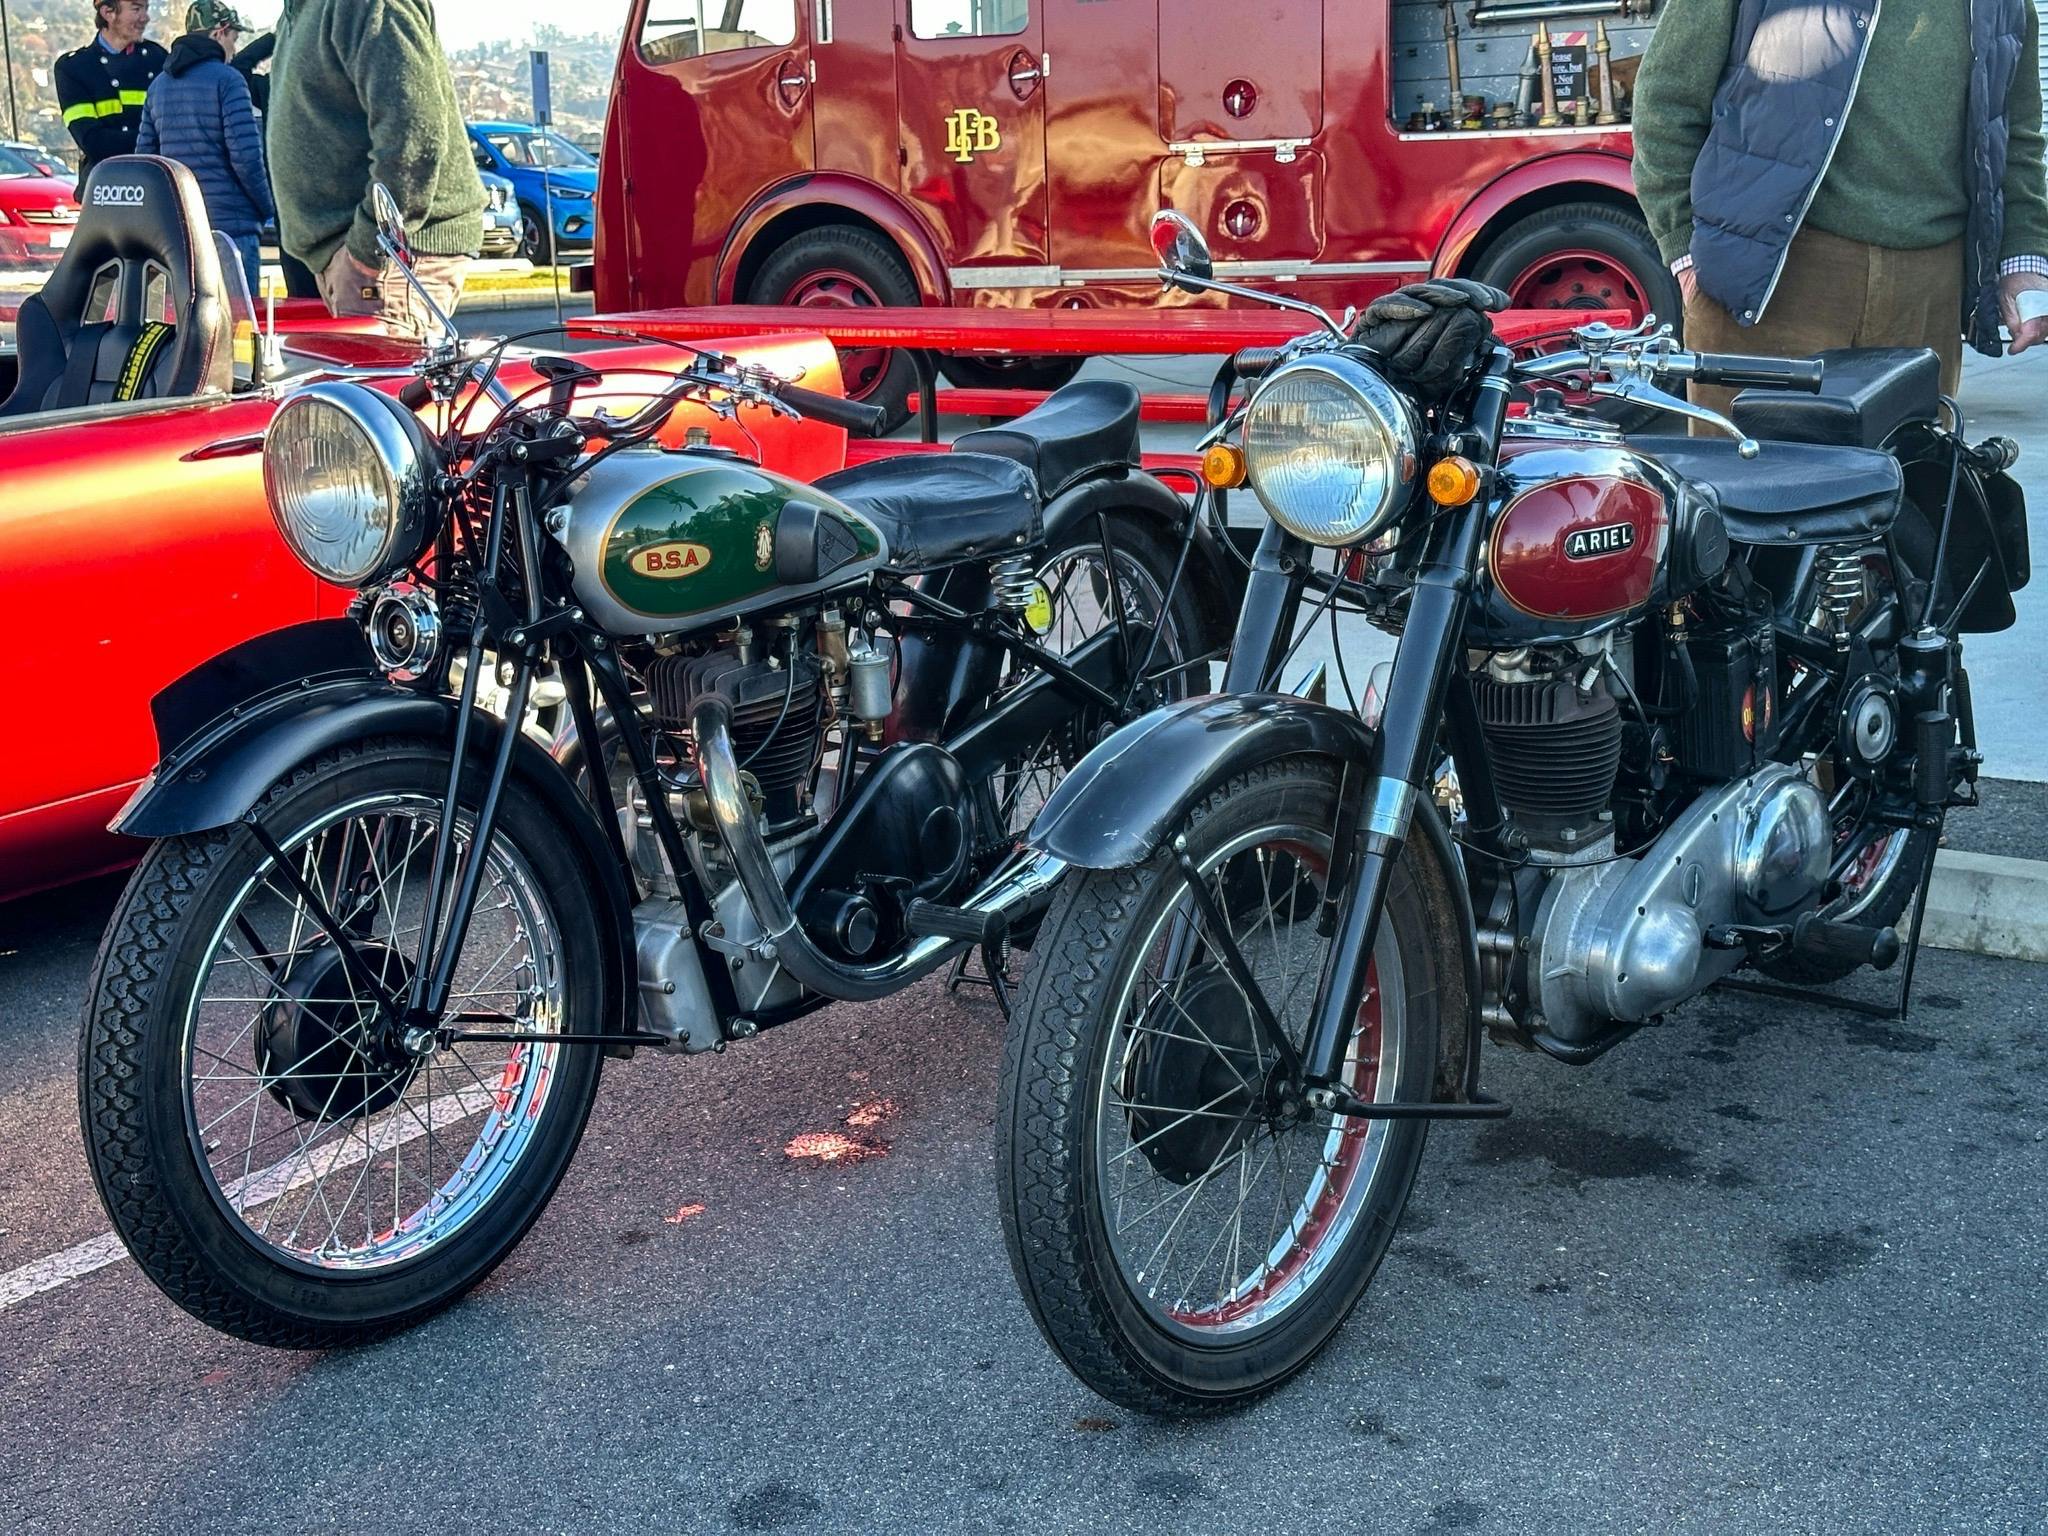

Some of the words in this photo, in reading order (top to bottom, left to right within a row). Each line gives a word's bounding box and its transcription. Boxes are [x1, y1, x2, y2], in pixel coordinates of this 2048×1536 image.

[1551, 52, 1572, 62] lease
[1569, 62, 1583, 73] but
[1558, 74, 1574, 84] Not
[93, 185, 145, 206] sparco
[1573, 527, 1631, 553] ARIEL
[646, 548, 699, 571] B.S.A
